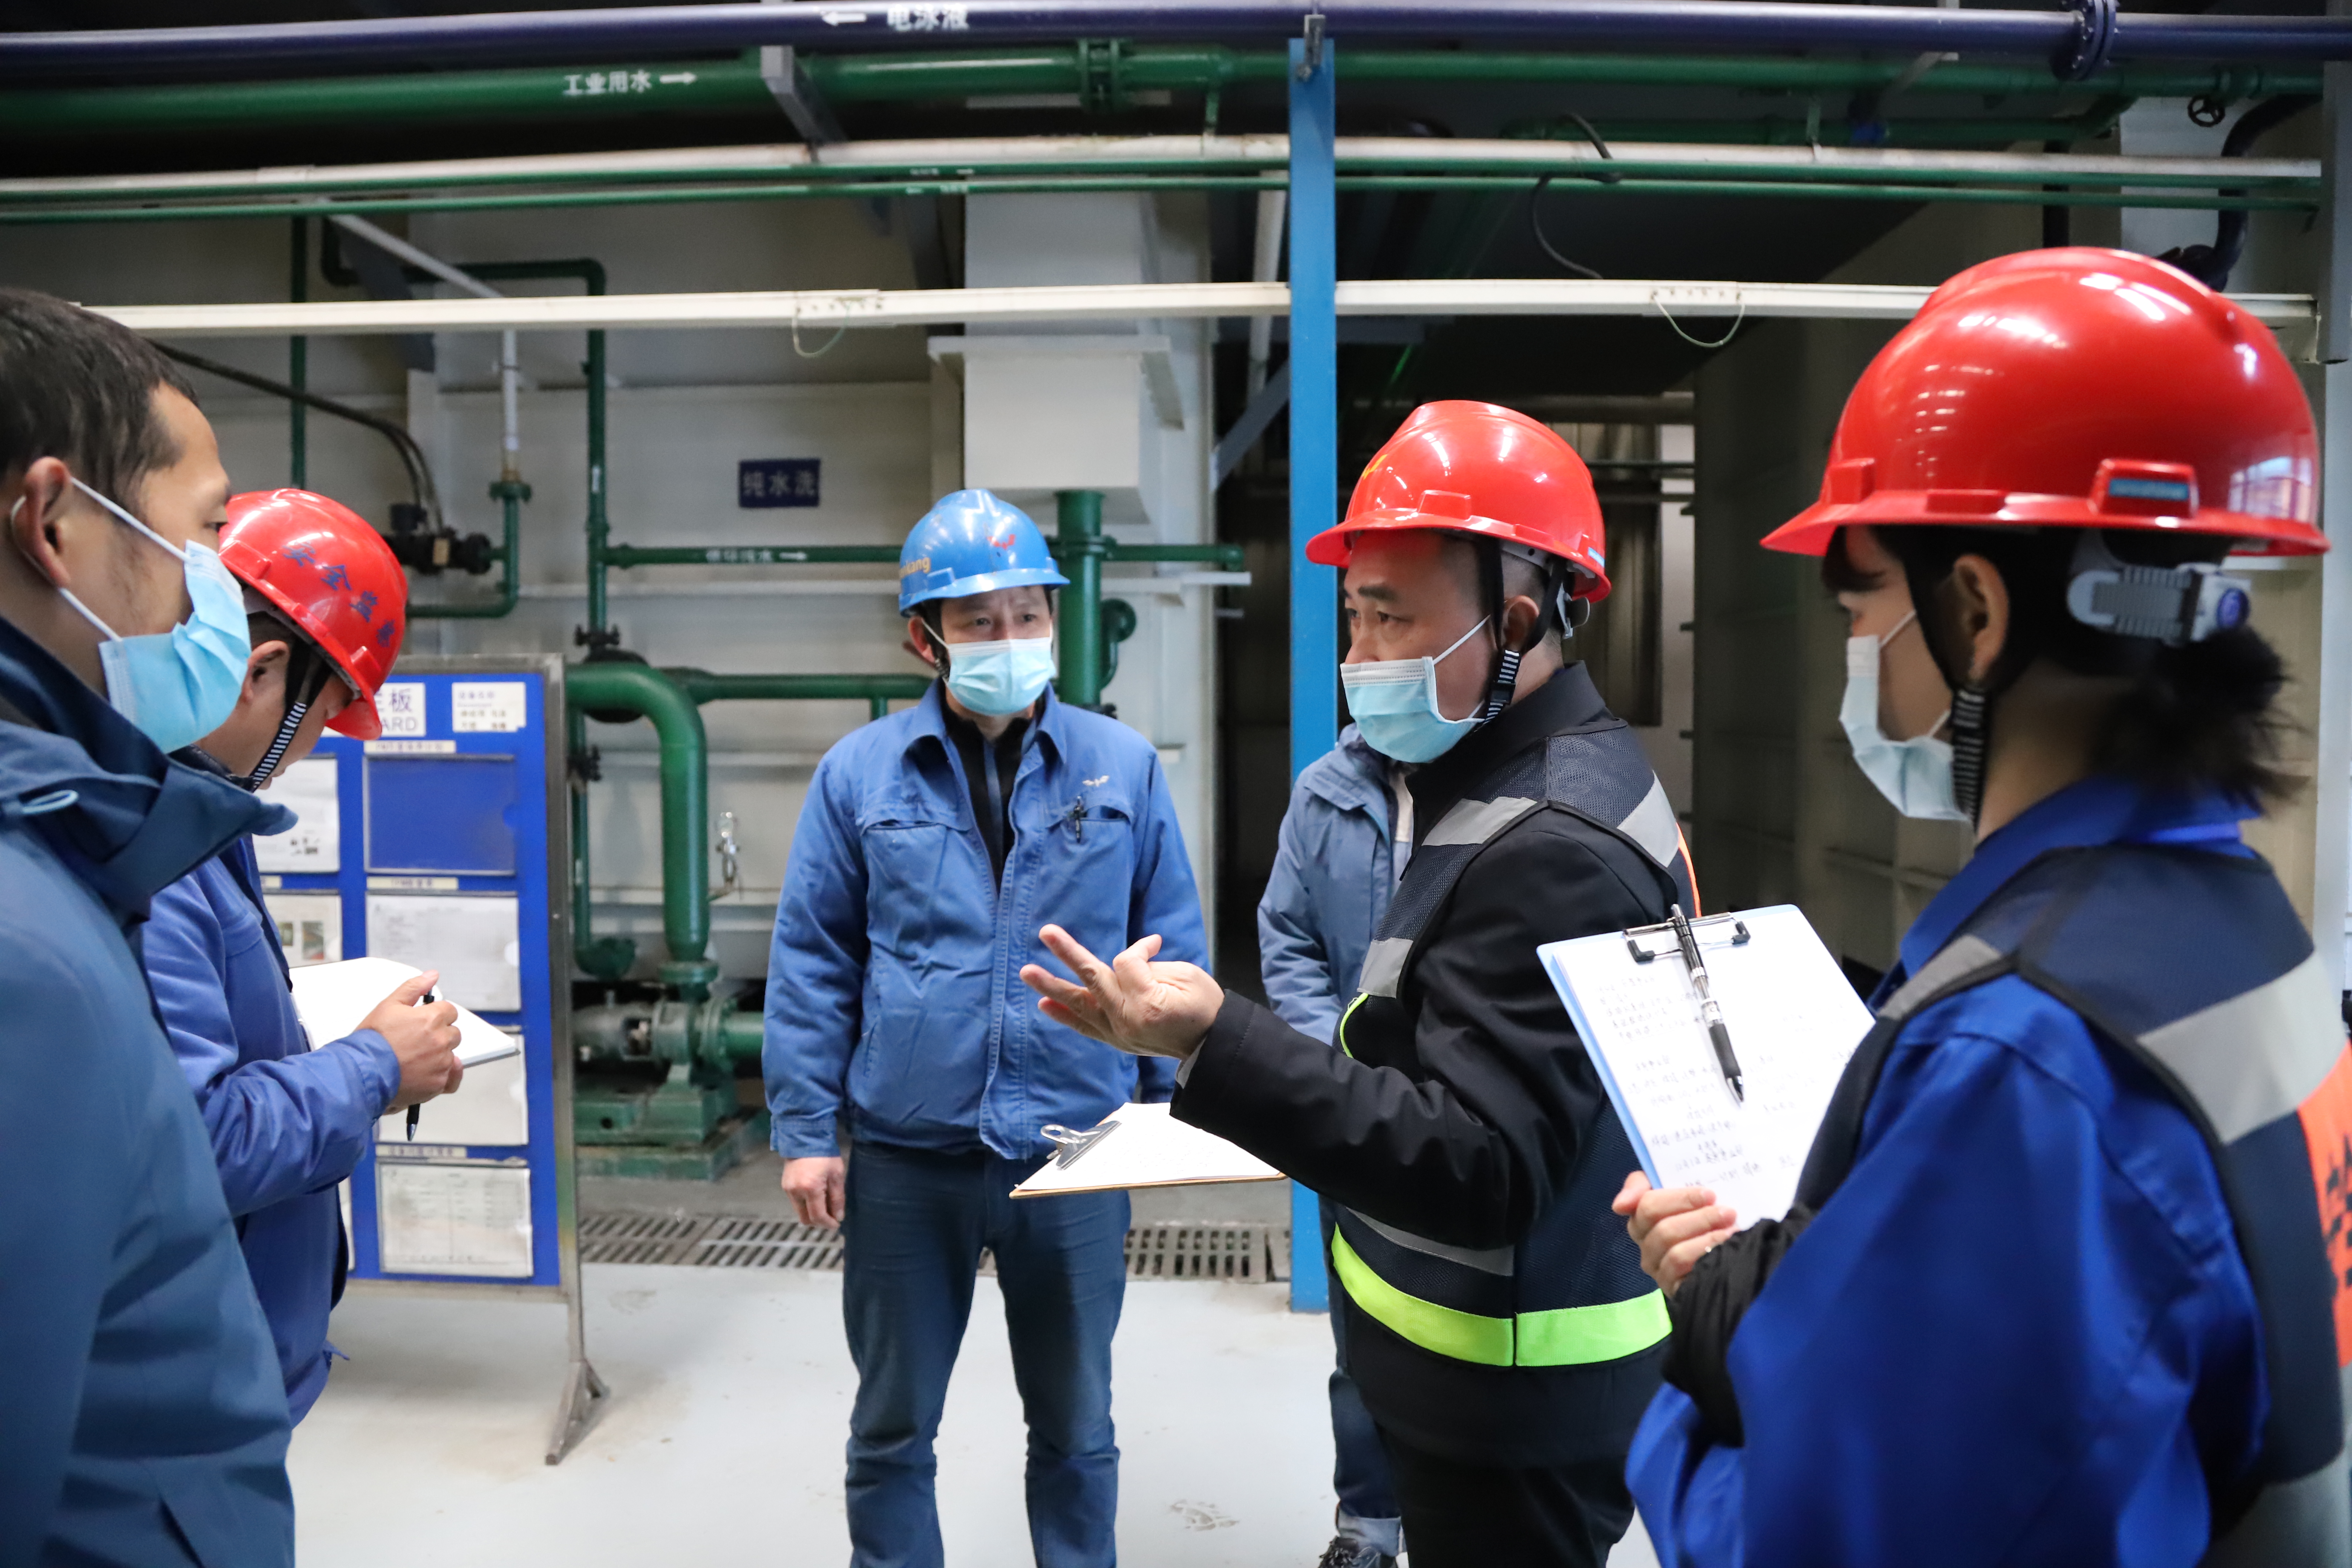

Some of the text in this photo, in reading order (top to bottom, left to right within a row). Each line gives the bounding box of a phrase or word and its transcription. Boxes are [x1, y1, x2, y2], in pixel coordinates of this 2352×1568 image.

[563, 69, 652, 95] 工业用水
[743, 471, 815, 498] 纯水洗
